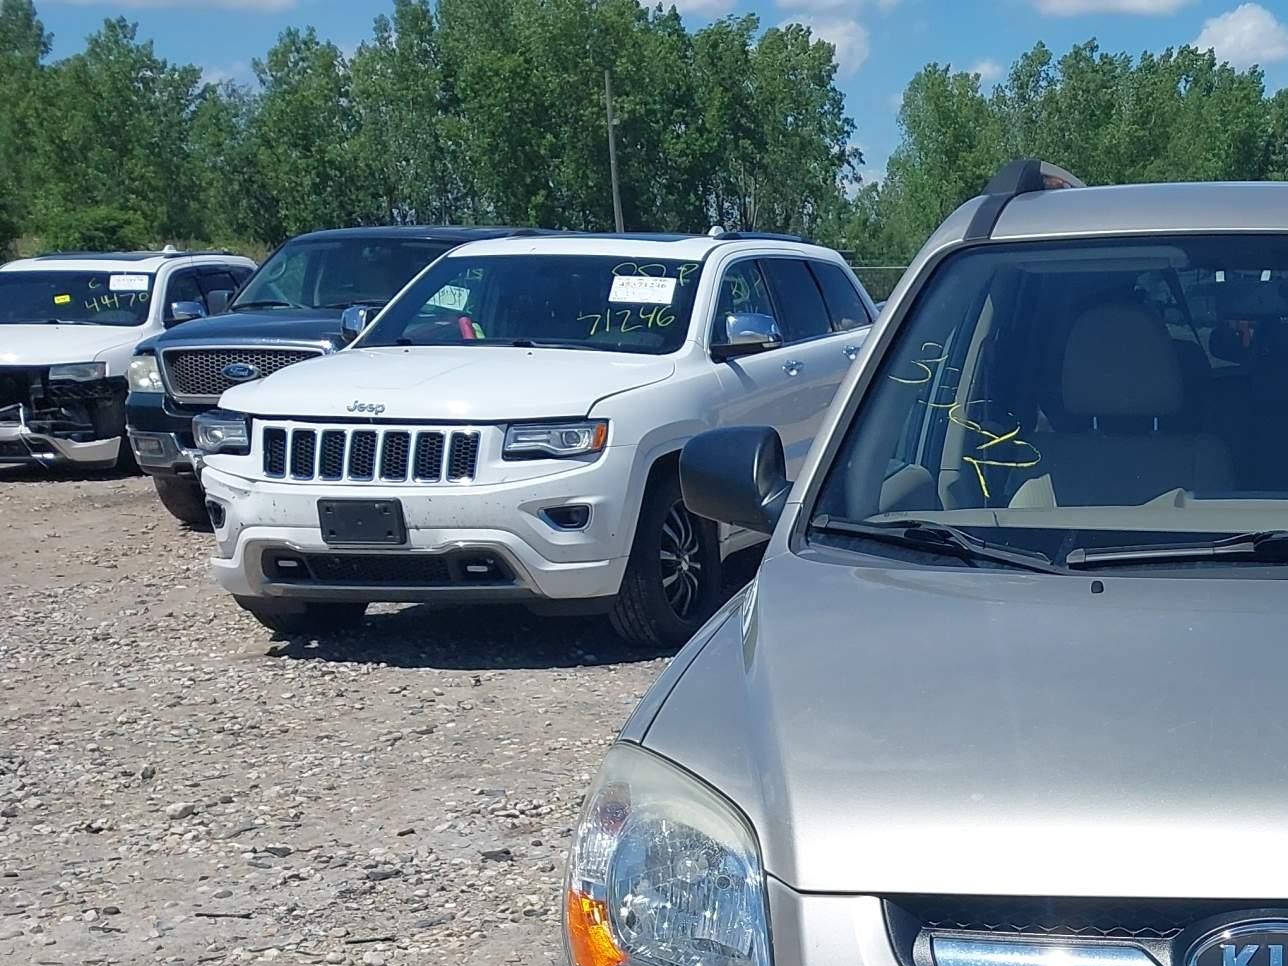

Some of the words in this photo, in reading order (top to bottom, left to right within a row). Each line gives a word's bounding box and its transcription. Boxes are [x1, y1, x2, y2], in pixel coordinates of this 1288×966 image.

[85, 292, 149, 312] 44170
[577, 305, 675, 335] 71246
[346, 400, 386, 415] Jeep
